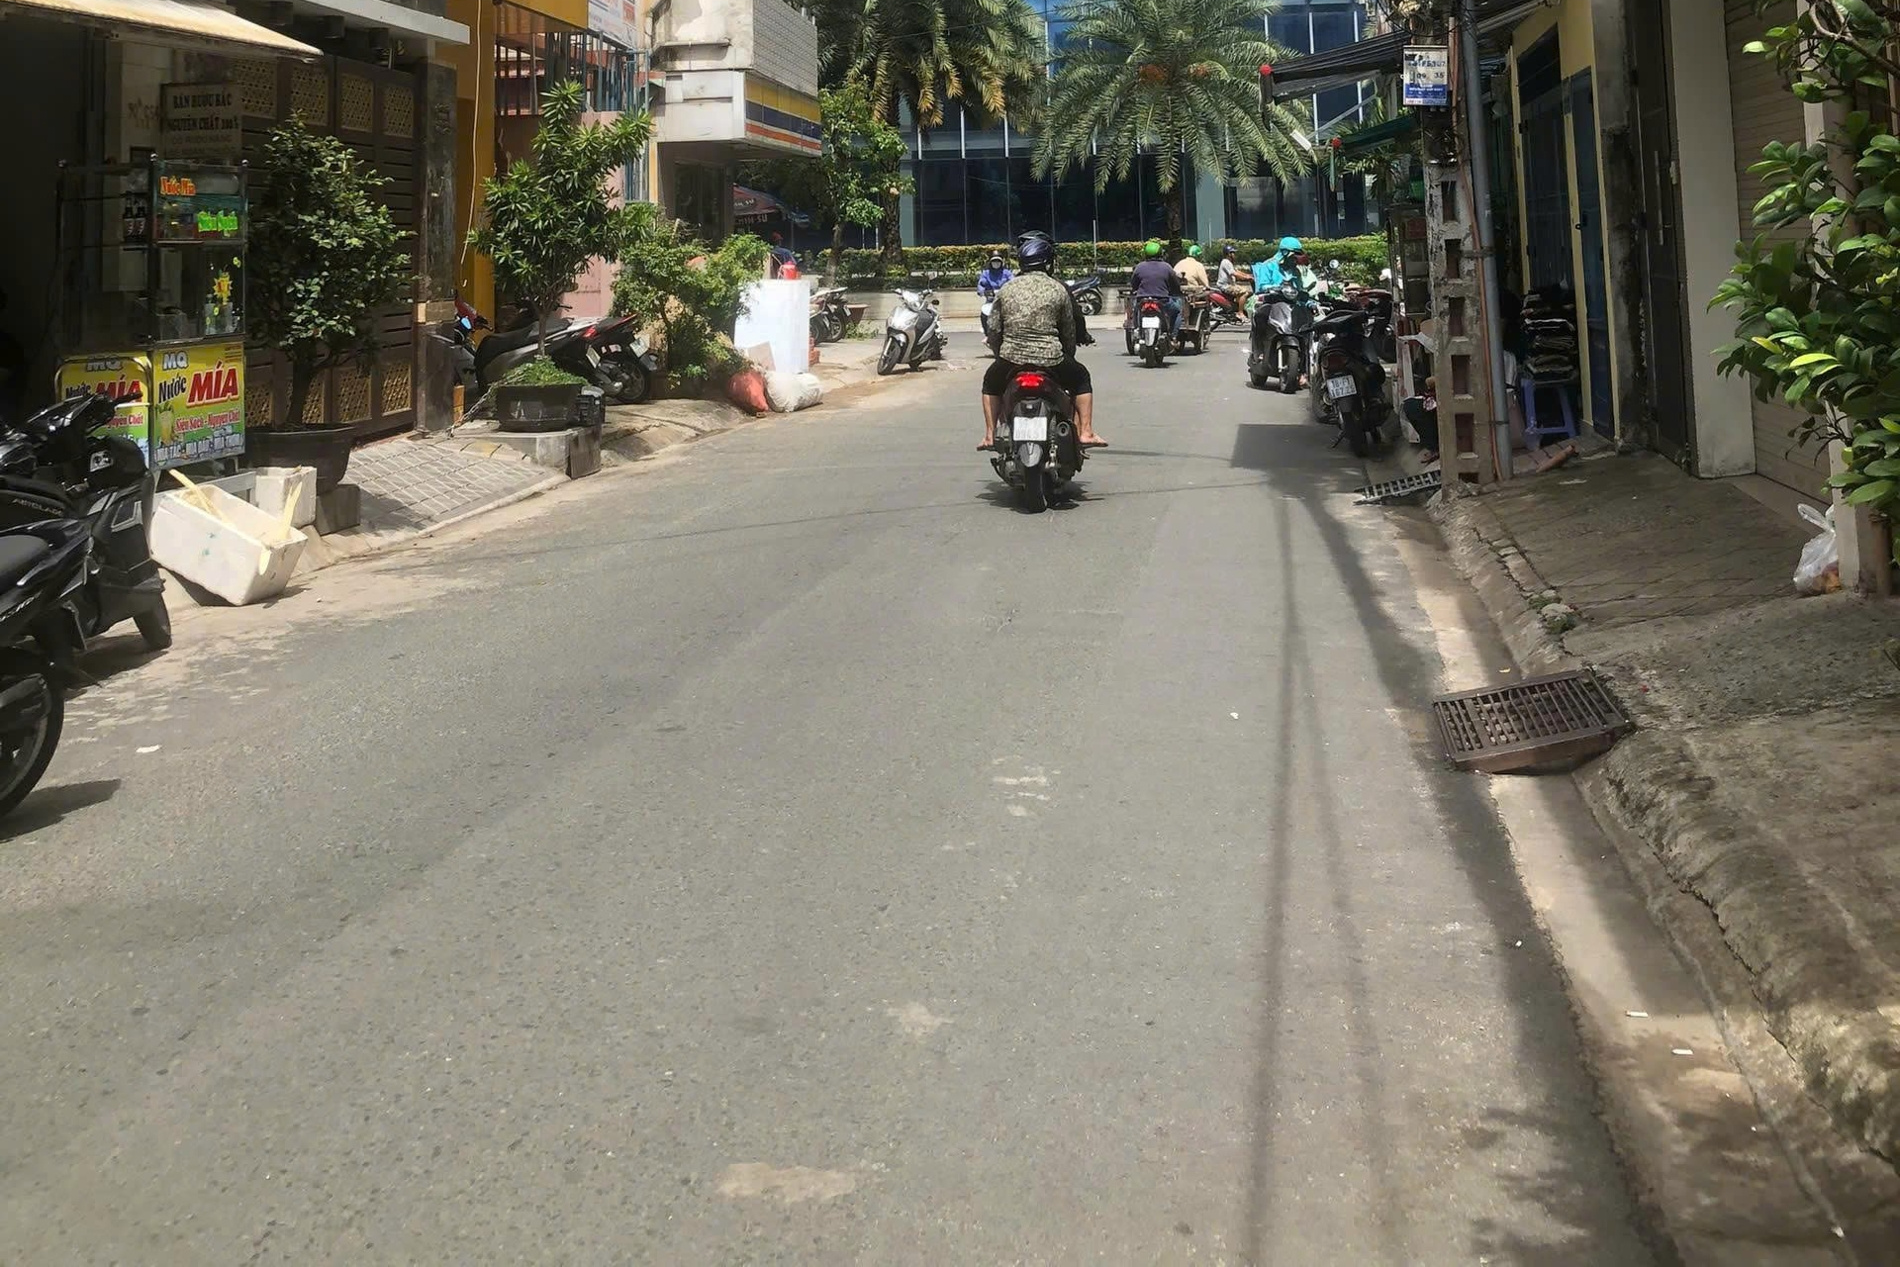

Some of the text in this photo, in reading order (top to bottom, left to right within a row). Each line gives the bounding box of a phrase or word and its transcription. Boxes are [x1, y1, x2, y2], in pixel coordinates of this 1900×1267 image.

[163, 351, 188, 370] MQ
[159, 360, 239, 406] Nước MÍA
